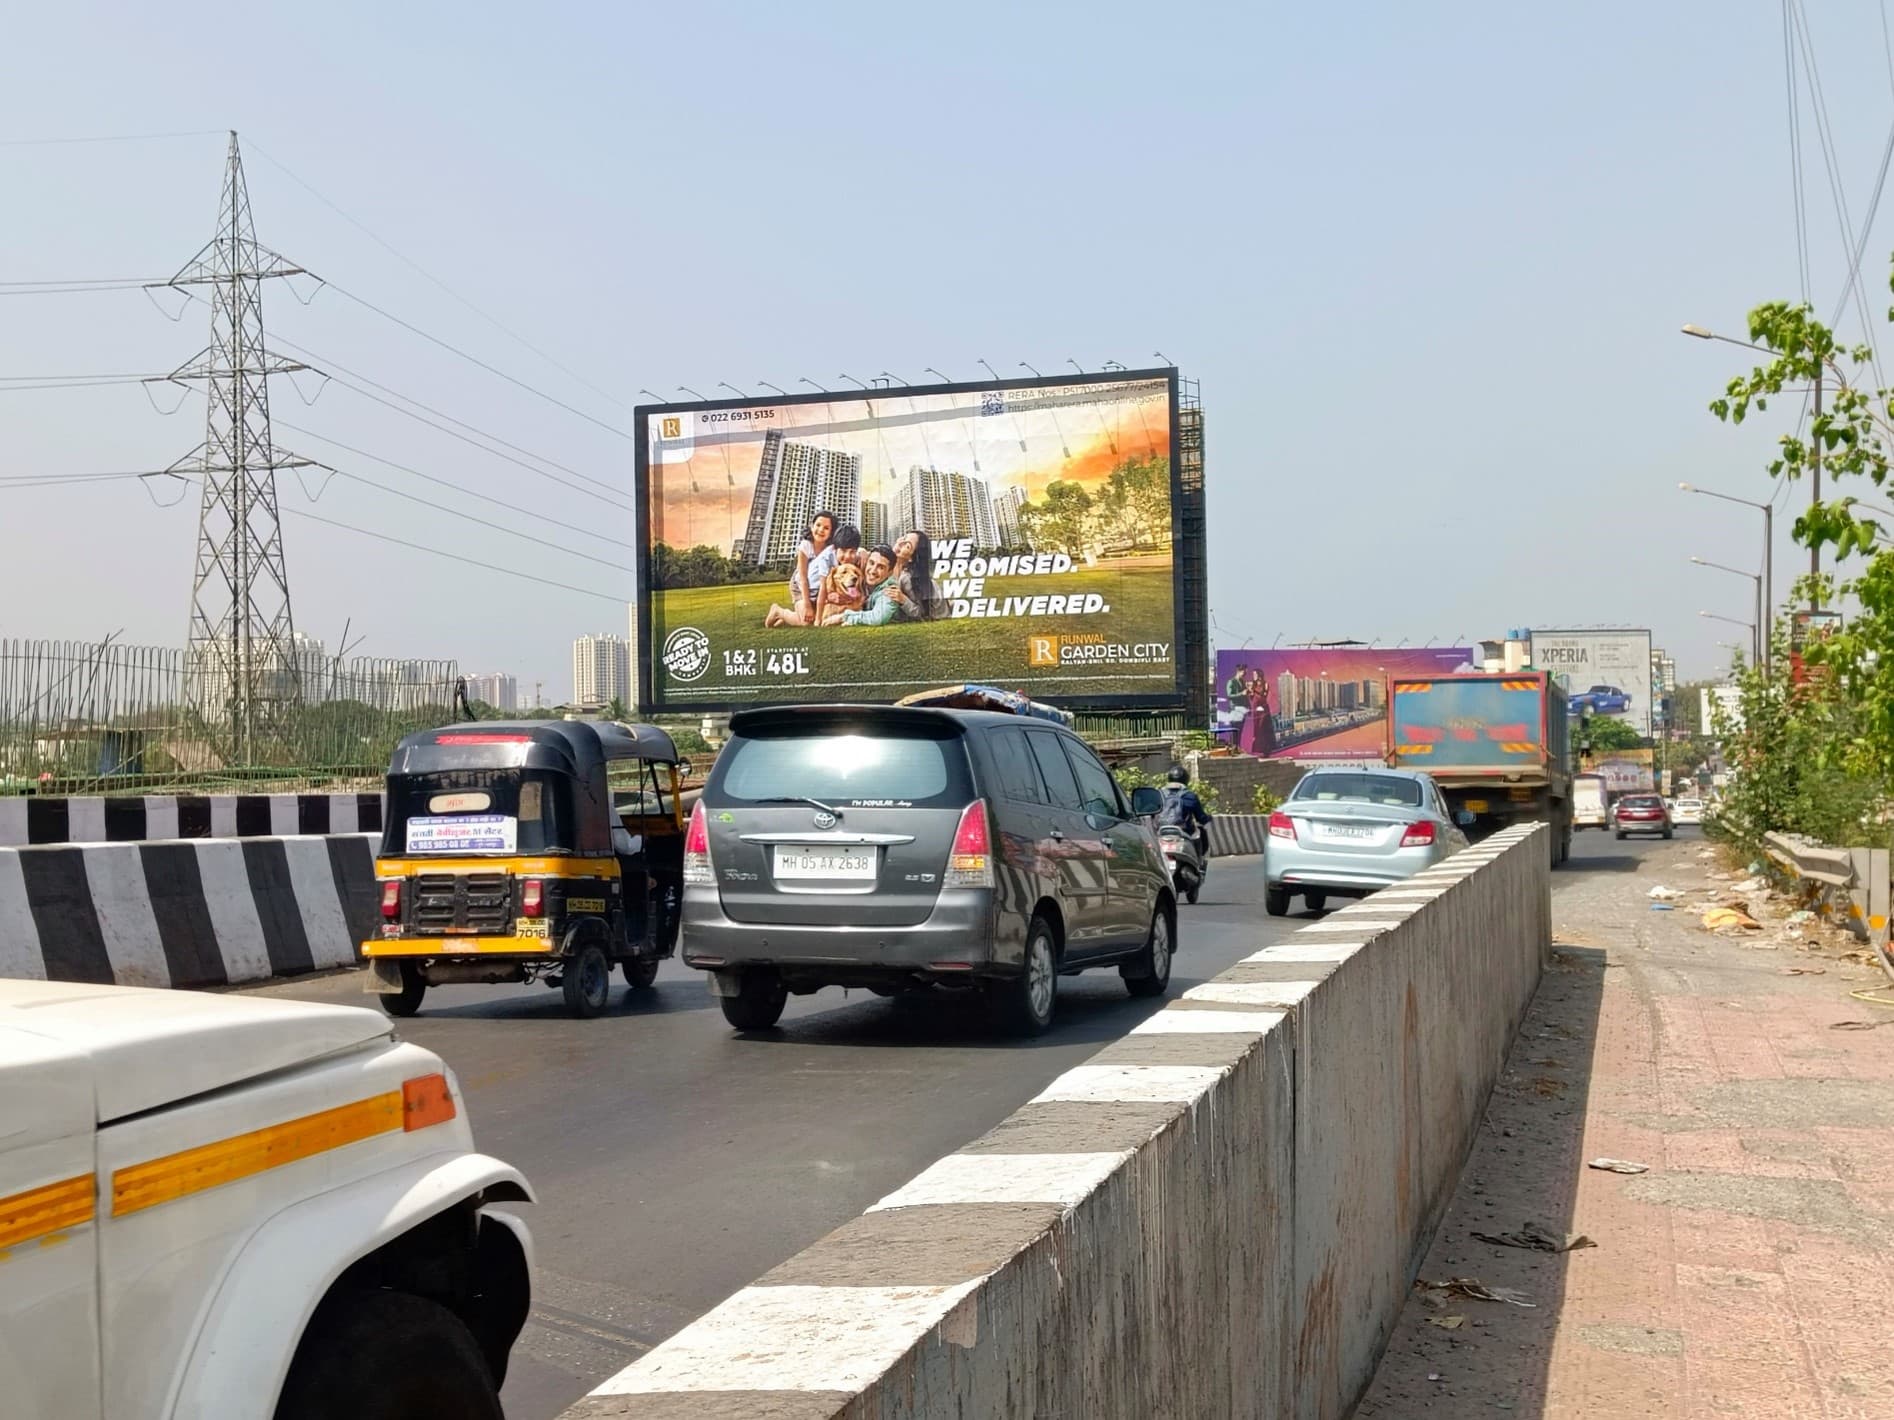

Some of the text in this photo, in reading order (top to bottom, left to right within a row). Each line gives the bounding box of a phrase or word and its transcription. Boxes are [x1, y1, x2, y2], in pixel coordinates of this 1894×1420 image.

[1008, 391, 1035, 400] RERA
[711, 409, 775, 422] 022 6931 5135
[666, 420, 678, 436] R
[931, 538, 973, 560] WE
[932, 553, 1078, 579] PROMISED.
[942, 578, 985, 599] WE
[951, 593, 1111, 618] DELIVERED.
[1061, 633, 1107, 645] RUNWAL
[662, 643, 694, 665] READY
[694, 637, 709, 649] TO
[1034, 639, 1054, 662] R
[1061, 643, 1169, 659] GARDEN CITY
[1542, 648, 1588, 663] XPERIA
[668, 652, 697, 672] MOVE
[697, 646, 709, 658] IN
[862, 799, 893, 807] POPULAR
[782, 856, 869, 869] MH 05 AX 2638
[519, 929, 546, 939] 7016
